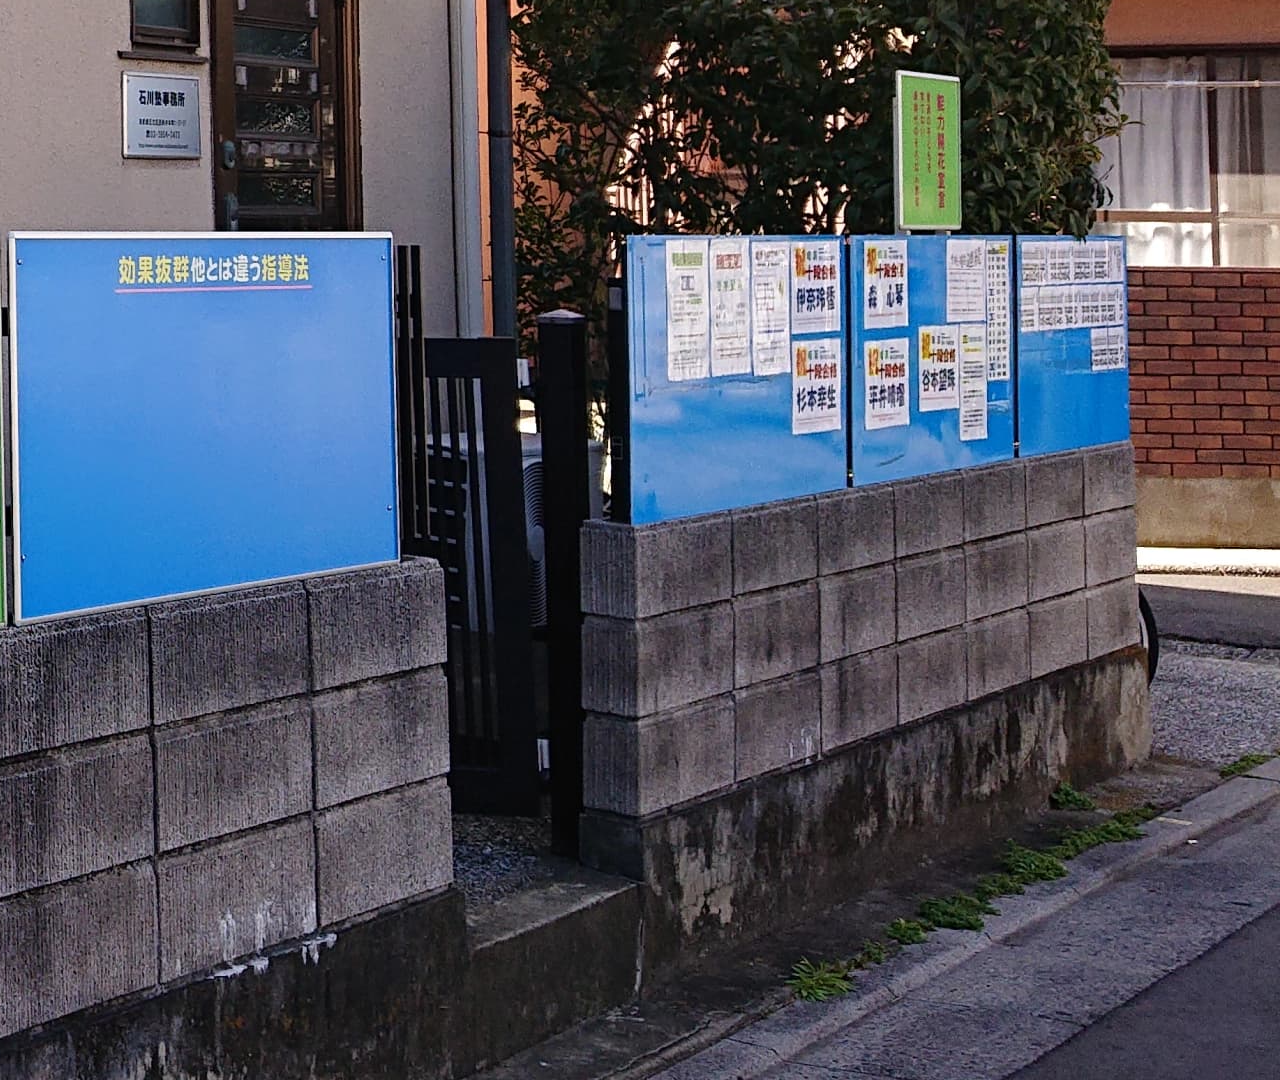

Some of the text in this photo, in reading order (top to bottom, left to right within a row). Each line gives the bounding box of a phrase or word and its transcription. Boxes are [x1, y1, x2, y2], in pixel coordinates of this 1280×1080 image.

[118, 254, 310, 286] 効果抜群他とは違う指導法
